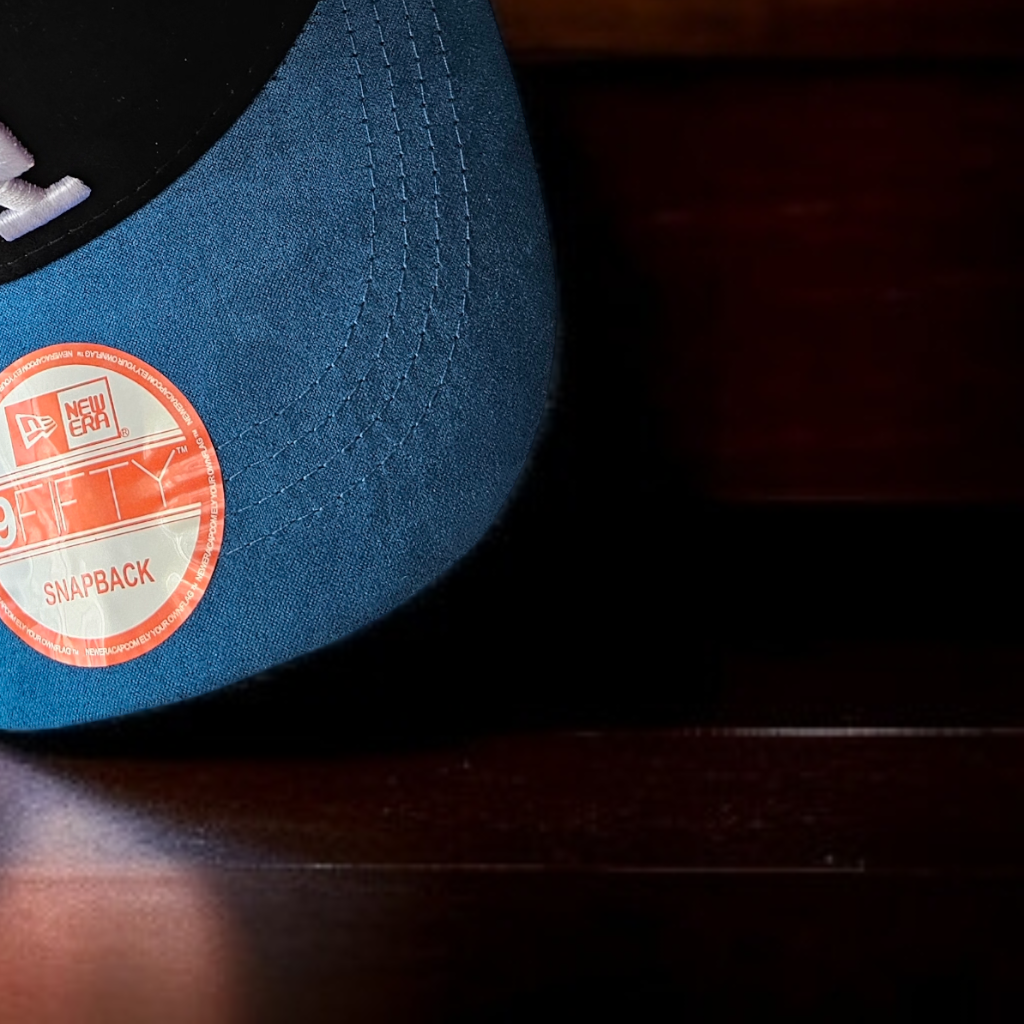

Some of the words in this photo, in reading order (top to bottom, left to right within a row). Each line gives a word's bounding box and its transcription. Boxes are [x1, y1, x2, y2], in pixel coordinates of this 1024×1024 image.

[64, 393, 106, 418] NEW
[68, 412, 111, 437] ERA
[43, 558, 155, 606] SNAPBACK
